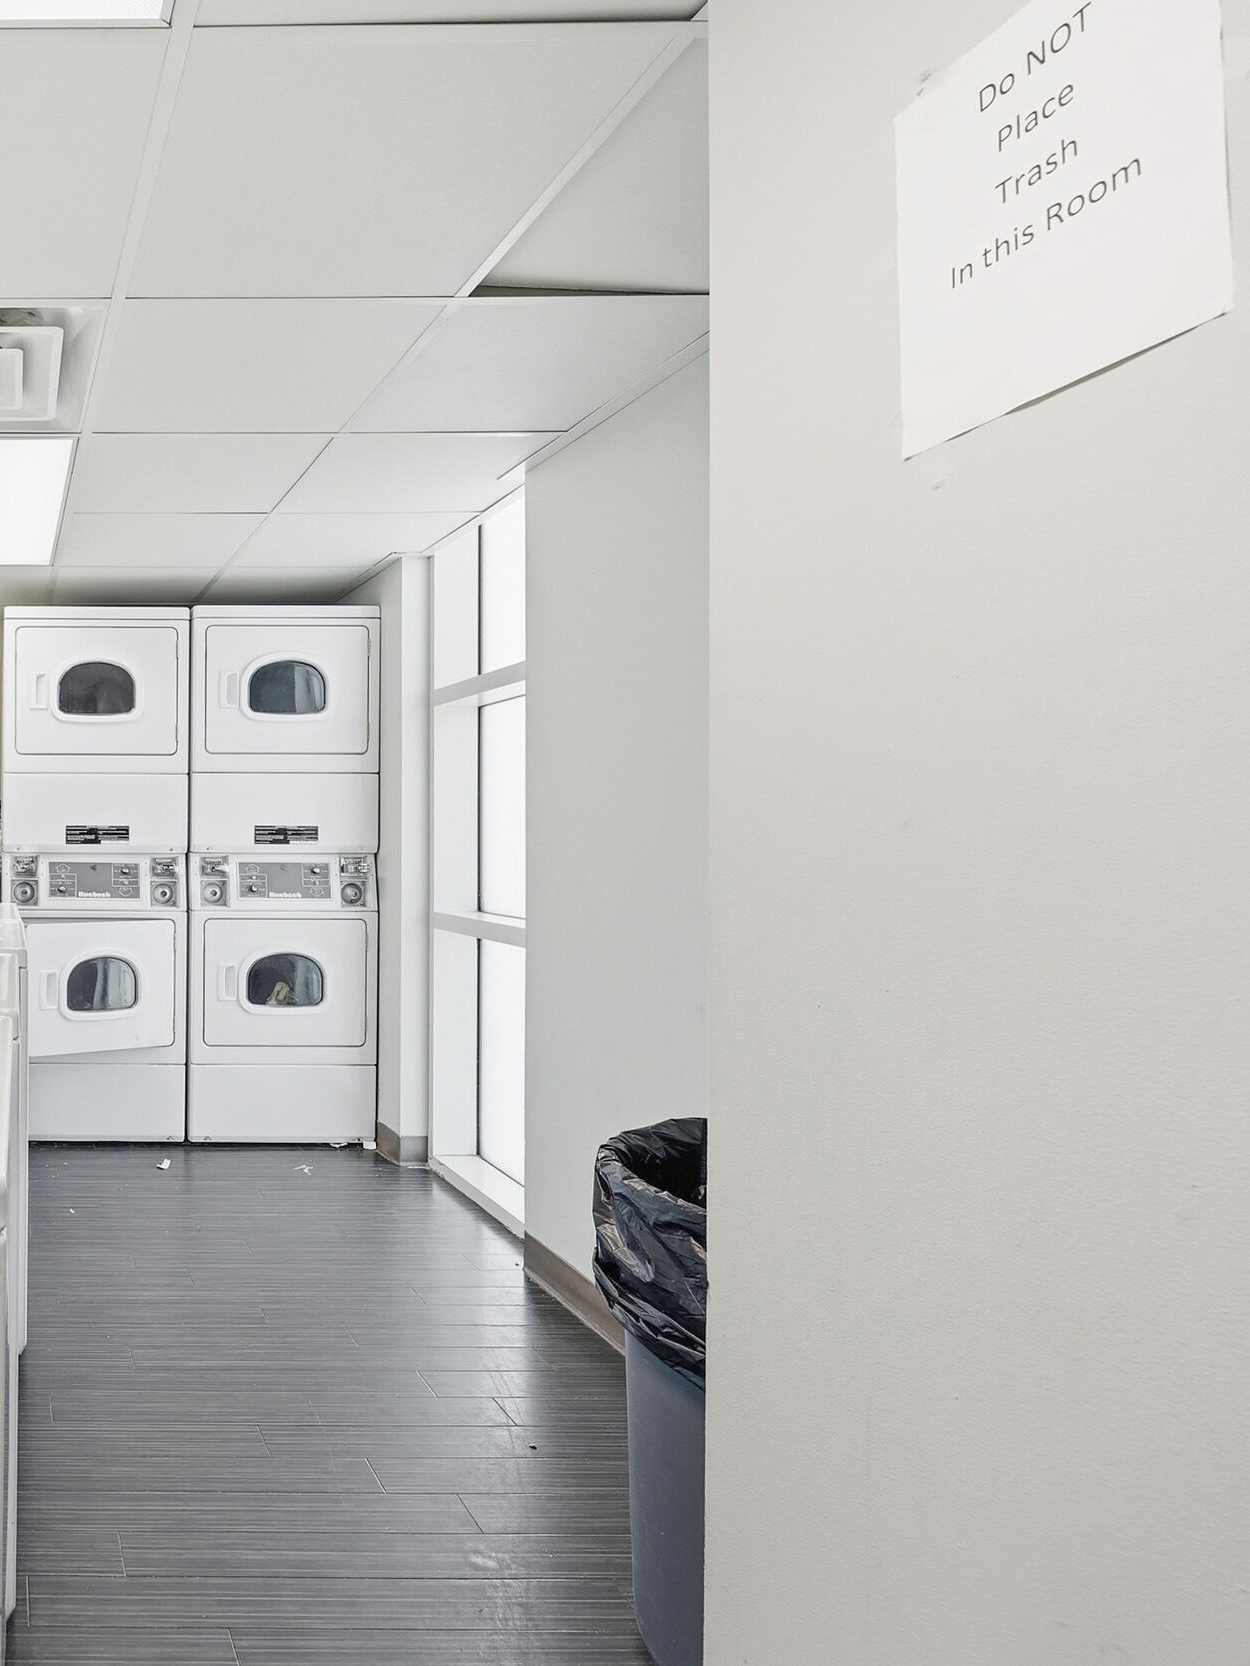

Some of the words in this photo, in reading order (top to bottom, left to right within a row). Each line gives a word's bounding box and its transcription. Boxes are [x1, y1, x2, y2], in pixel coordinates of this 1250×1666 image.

[978, 72, 1016, 113] Do
[1026, 1, 1093, 76] NOT
[997, 83, 1075, 152] Place
[994, 138, 1078, 204] Trash
[951, 260, 973, 289] In
[982, 223, 1035, 268] this
[1046, 156, 1142, 231] Room
